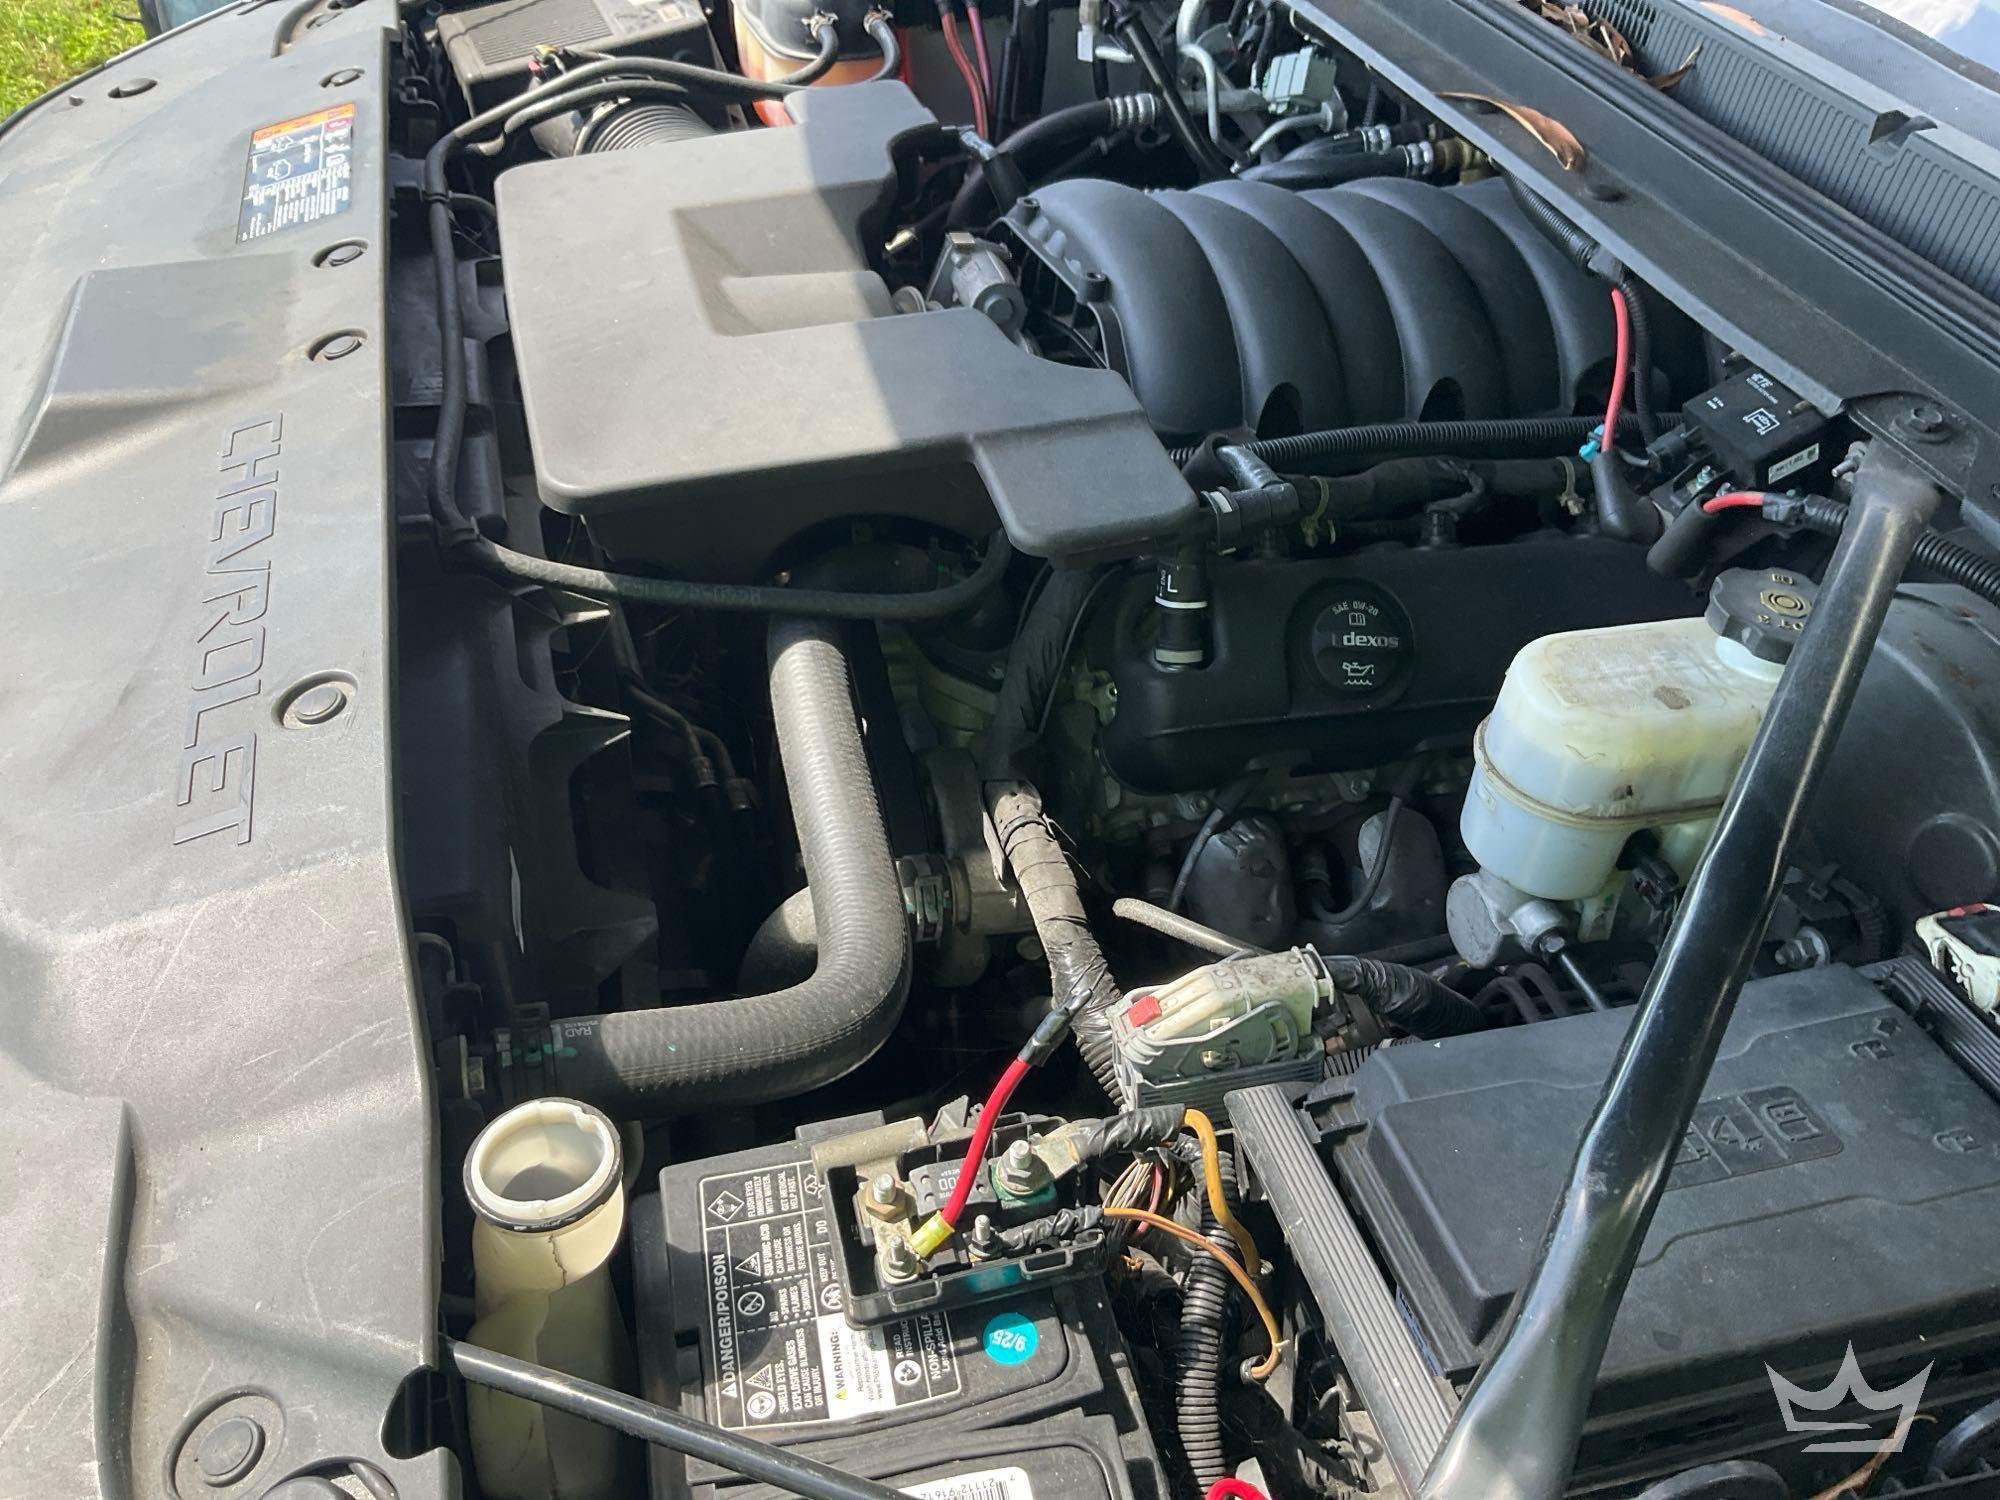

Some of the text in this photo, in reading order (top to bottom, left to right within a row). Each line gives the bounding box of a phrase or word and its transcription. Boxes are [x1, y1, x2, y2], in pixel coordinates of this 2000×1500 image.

[1332, 601, 1379, 616] SAE 0W-20
[173, 411, 284, 846] CHEVROLET
[1343, 631, 1399, 648] dexos
[566, 1026, 592, 1038] RAD
[745, 1181, 756, 1217] FLUSH EYES
[754, 1176, 764, 1216] IMMEDIATELY
[762, 1174, 774, 1214] WITH WATER.
[778, 1171, 789, 1210] GET MEDICAL
[788, 1176, 798, 1208] HELP FAST.
[760, 1224, 774, 1276] SULFURIC ACID
[774, 1238, 784, 1273] CAN CAUSE
[783, 1226, 795, 1271] BLINDNESS OR
[796, 1246, 806, 1269] SEVERE
[817, 1253, 828, 1282] KEEP OUT
[712, 1254, 736, 1383] DANGER/POISON
[769, 1312, 779, 1322] NO
[894, 1334, 904, 1358] READ
[901, 1320, 914, 1356] INSTRUC
[920, 1315, 942, 1379] NON-SPILLA
[935, 1328, 947, 1347] Acid
[992, 1330, 1026, 1352] 9/25
[785, 1340, 802, 1410] EXPLOSIVE GASES
[796, 1328, 813, 1408] CAN CAUSE BLINDNESS
[831, 1331, 845, 1389] WARNING:
[775, 1360, 788, 1413] SHIELD EYES.
[811, 1366, 823, 1406] OR INJURY.
[960, 1478, 994, 1494] 21112
